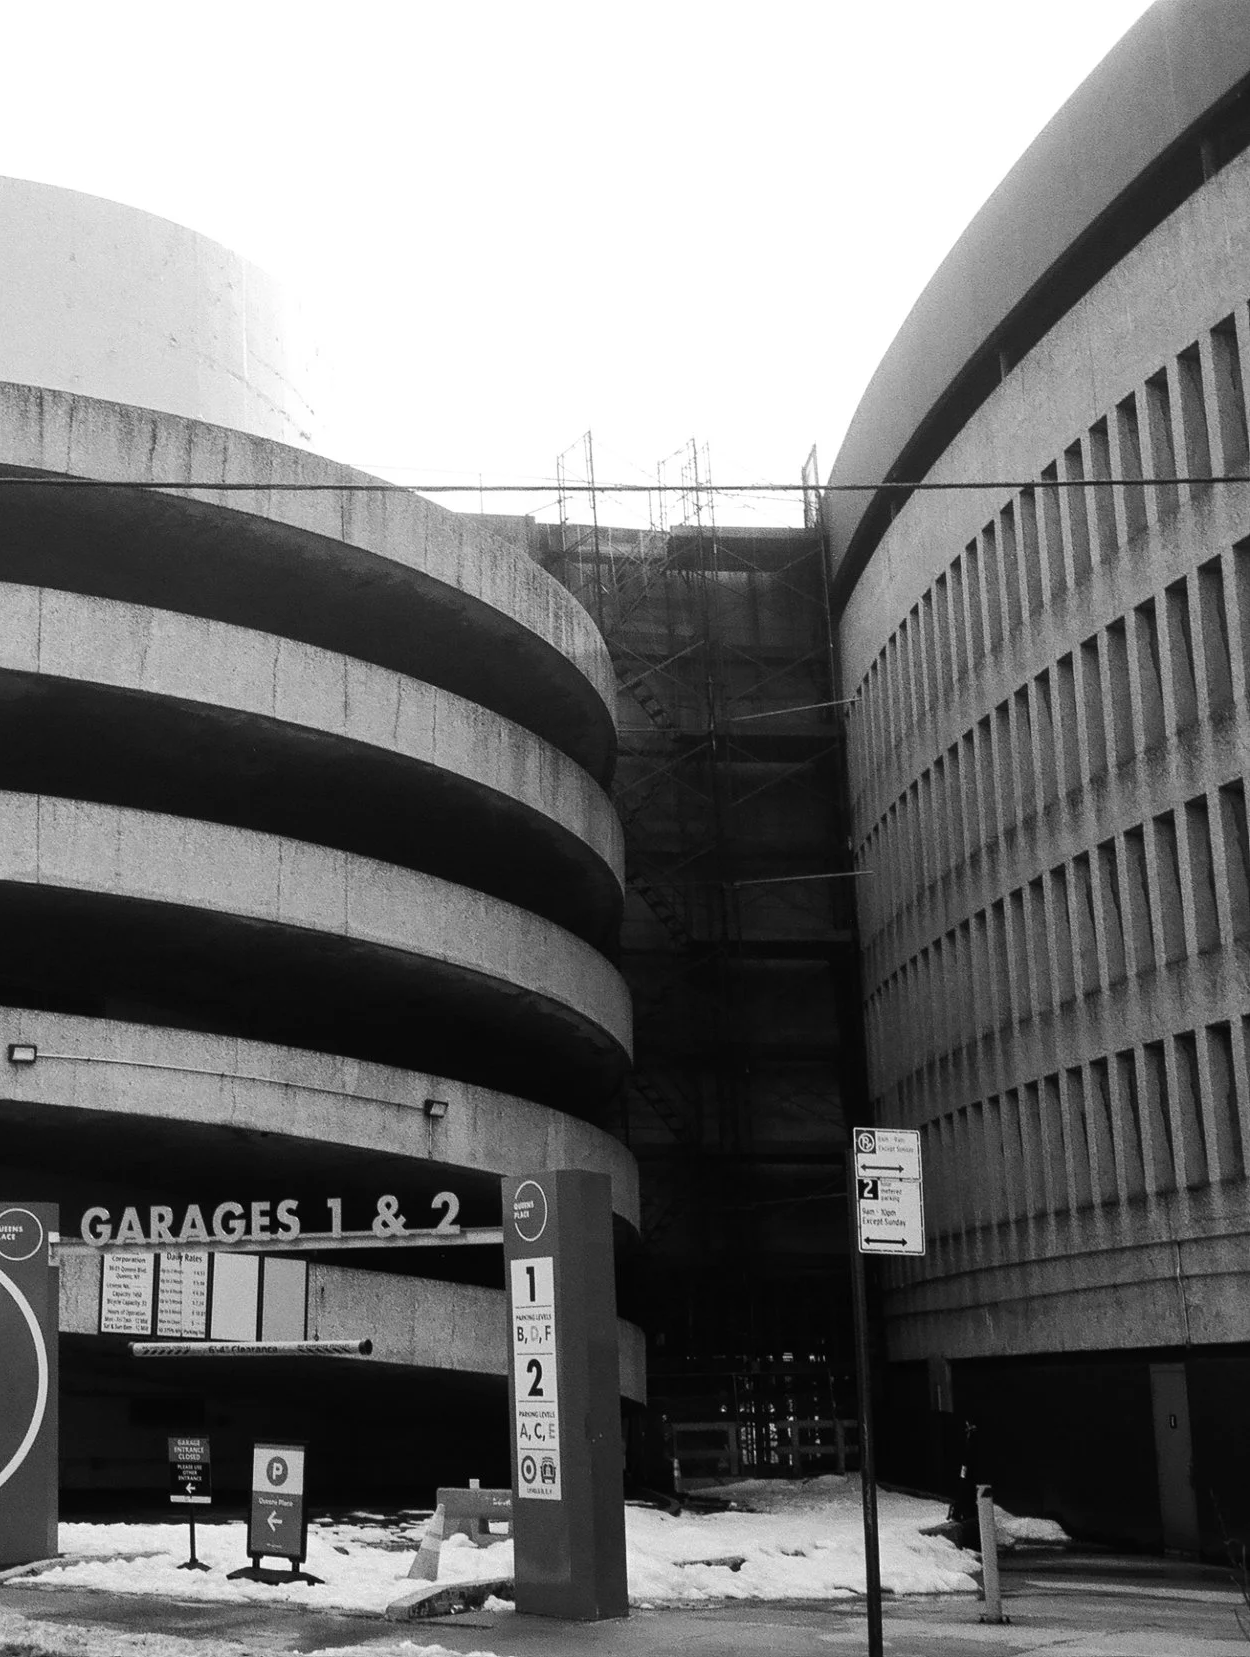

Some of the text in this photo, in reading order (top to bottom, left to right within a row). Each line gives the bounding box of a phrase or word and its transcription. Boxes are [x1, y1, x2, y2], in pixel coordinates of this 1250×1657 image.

[863, 1180, 874, 1198] 2
[80, 1191, 461, 1248] GARAGES 1 & 2
[862, 1217, 906, 1228] Except Sunday
[111, 1255, 146, 1264] Corporation
[184, 1253, 203, 1263] Rates
[526, 1266, 536, 1303] 1
[536, 1313, 552, 1321] LEVELS
[517, 1325, 551, 1344] B, D, F
[231, 1345, 278, 1354] Clearance
[527, 1358, 544, 1397] 2
[518, 1410, 556, 1419] PARKING LEVELS
[520, 1422, 556, 1442] A, C, E
[178, 1453, 201, 1461] CLOSED
[272, 1462, 283, 1480] P
